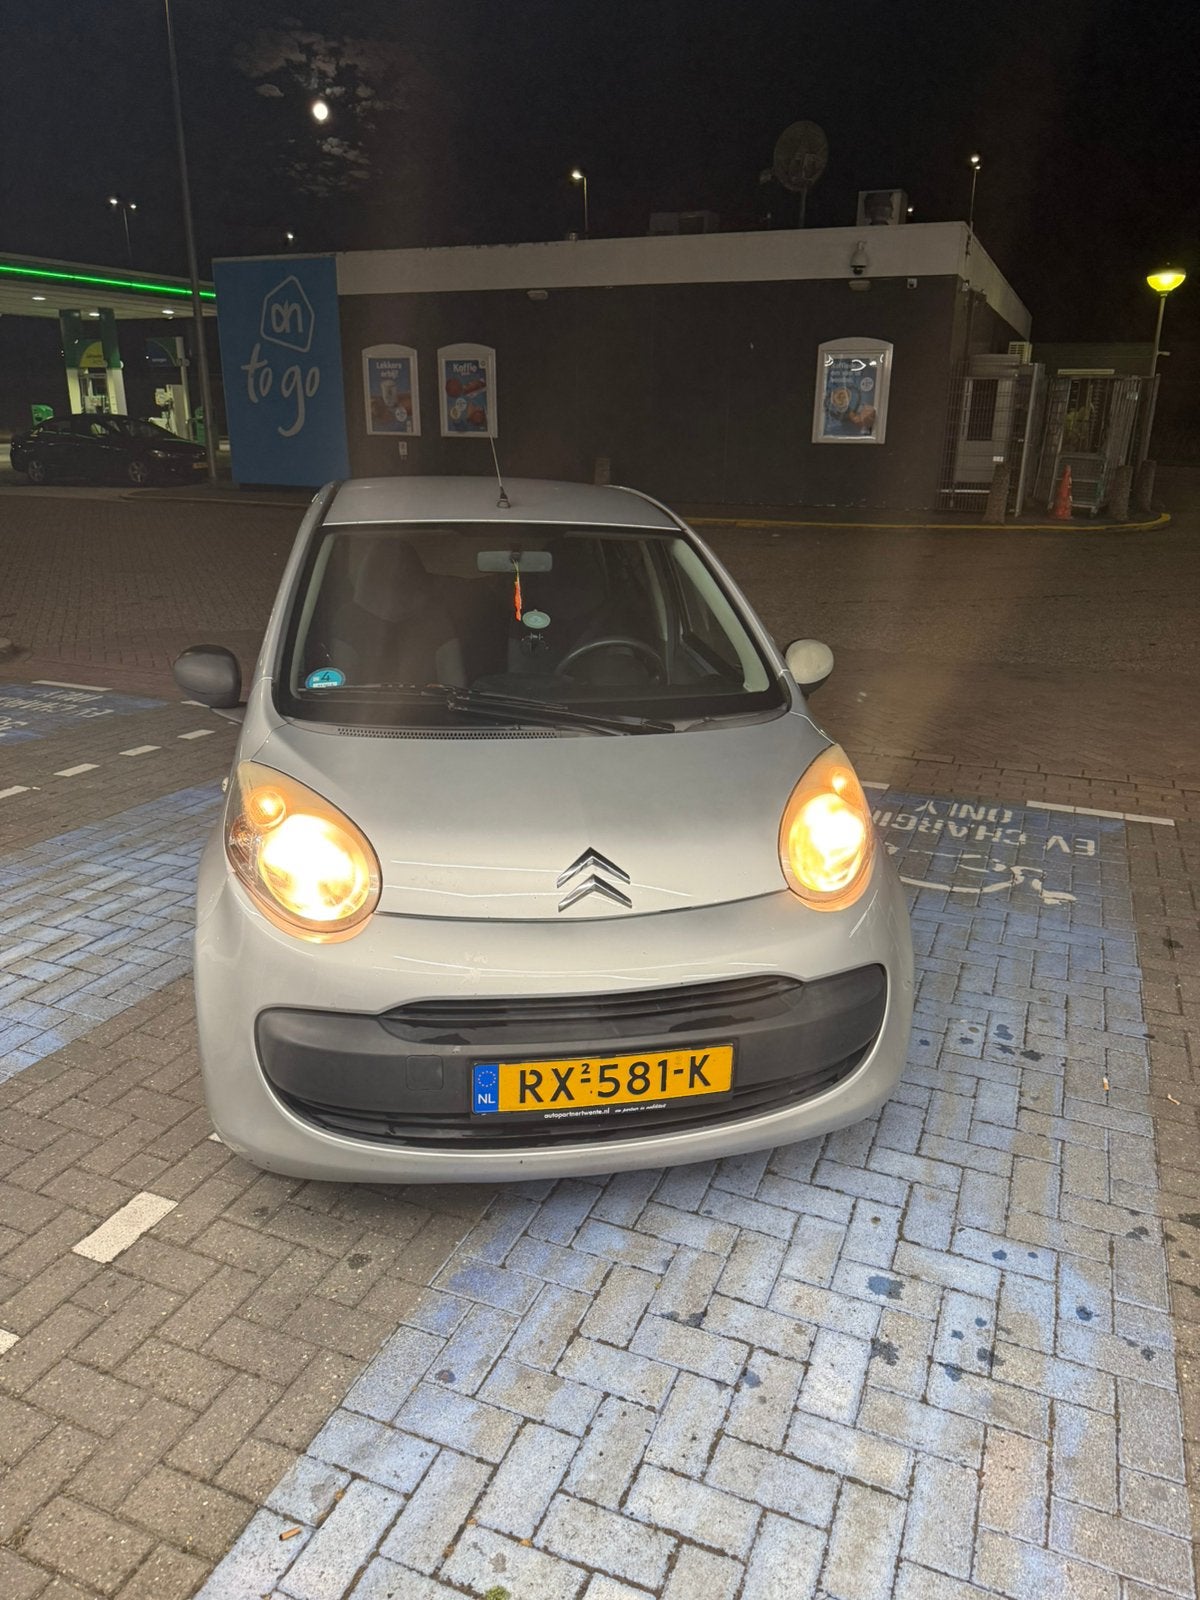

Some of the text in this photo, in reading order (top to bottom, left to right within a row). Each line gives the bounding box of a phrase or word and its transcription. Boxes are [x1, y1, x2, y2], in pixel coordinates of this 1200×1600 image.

[453, 362, 477, 373] Koffie
[241, 343, 320, 437] to go
[1043, 835, 1095, 857] EV
[477, 1094, 496, 1105] NL
